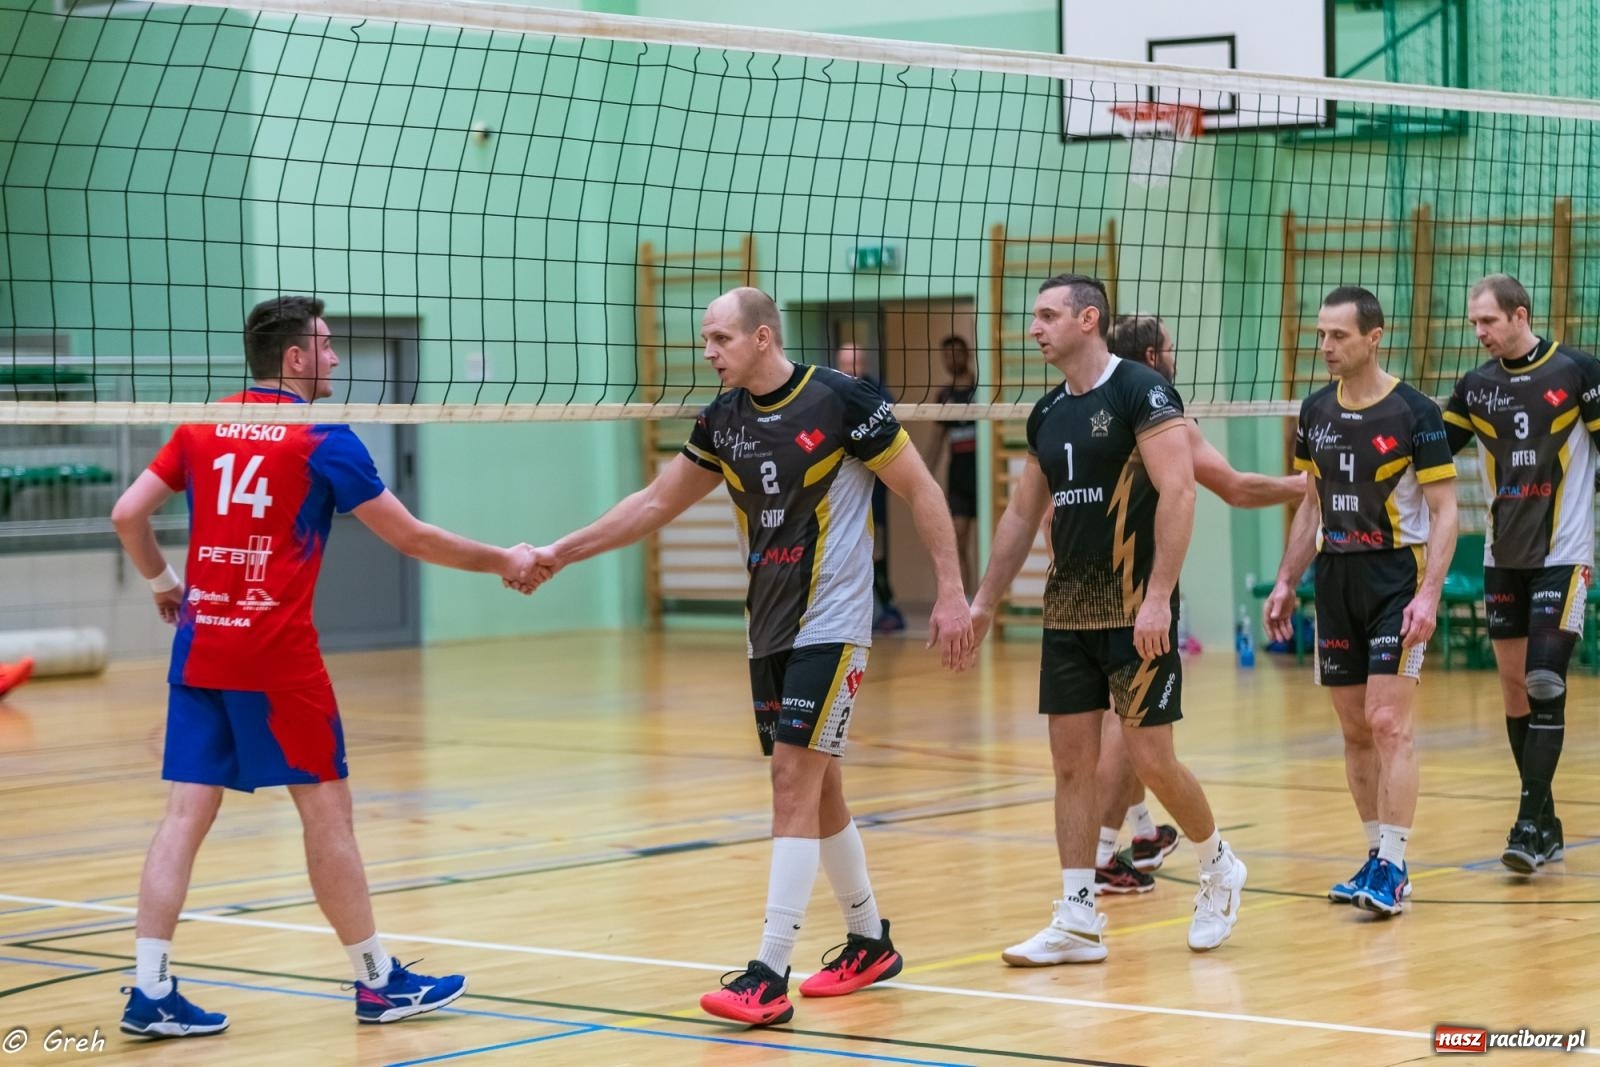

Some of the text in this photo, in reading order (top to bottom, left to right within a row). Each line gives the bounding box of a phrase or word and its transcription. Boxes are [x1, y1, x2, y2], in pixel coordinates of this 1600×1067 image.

[215, 424, 287, 441] GRYSKO
[1513, 411, 1529, 439] 3
[760, 460, 780, 494] 2
[1064, 442, 1074, 482] 1
[1340, 453, 1355, 483] 4
[212, 452, 273, 519] 14
[836, 706, 850, 738] 2
